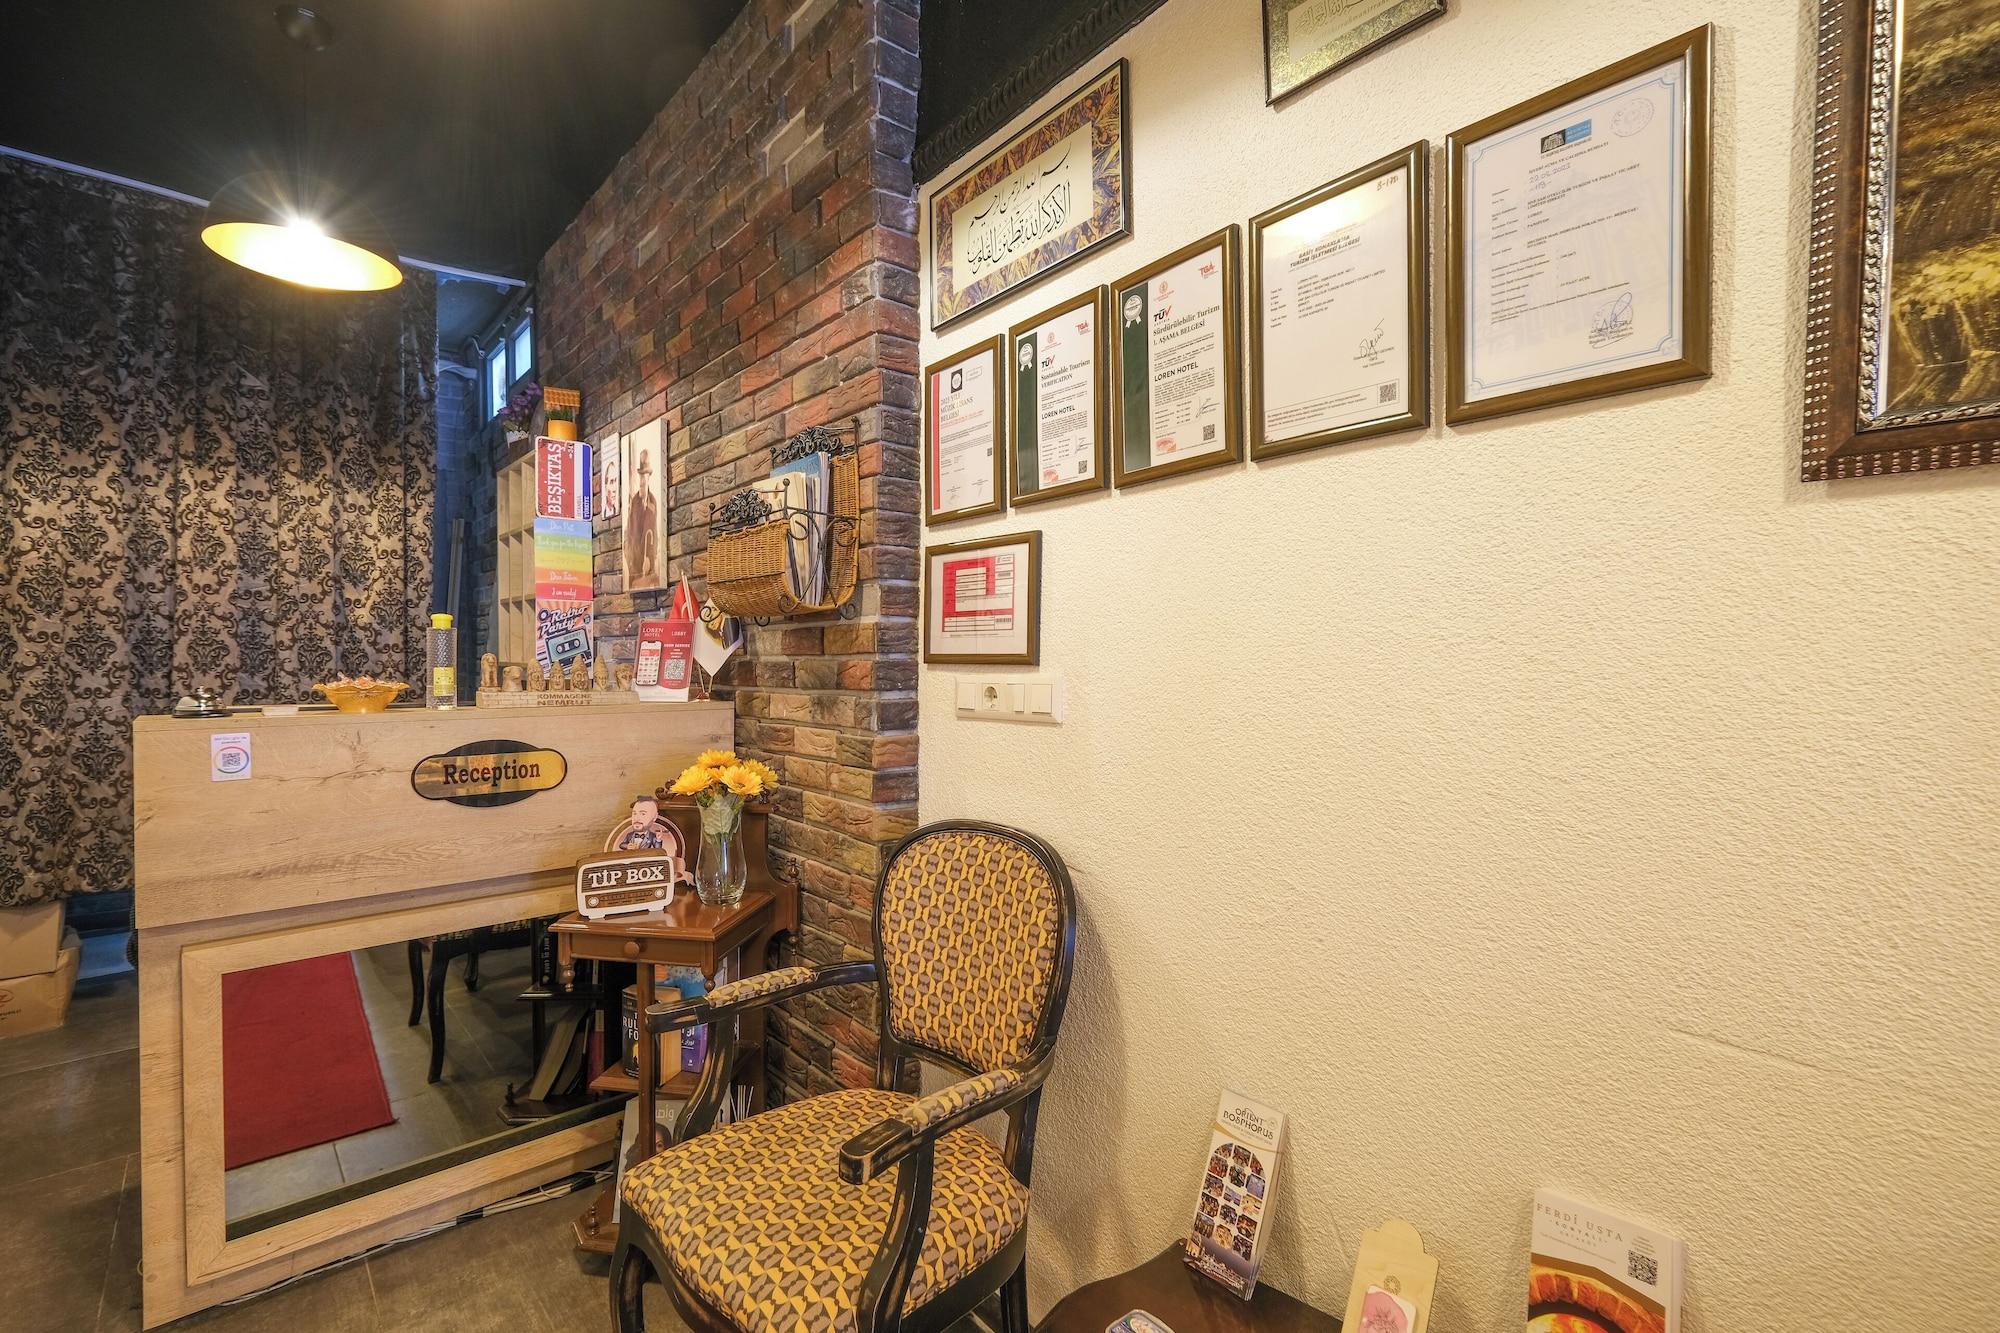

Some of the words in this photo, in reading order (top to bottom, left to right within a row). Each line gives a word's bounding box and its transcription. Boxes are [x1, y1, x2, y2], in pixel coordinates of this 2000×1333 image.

[1197, 305, 1220, 319] Turizm
[1041, 365, 1068, 381] Sustainable
[1069, 359, 1091, 371] Tourism
[1154, 369, 1176, 382] LOREN
[1177, 361, 1199, 374] HOTEL
[1041, 409, 1058, 420] LOREN
[1058, 405, 1076, 415] HOTEL
[544, 443, 566, 514] BEŞİKTAŞ
[551, 605, 590, 624] Retro
[540, 618, 575, 637] Party
[443, 759, 541, 787] Reception
[626, 865, 665, 884] BOX
[622, 1016, 639, 1031] RUL
[628, 1029, 639, 1040] FO
[1223, 1110, 1274, 1140] BOSPHORUS
[1235, 1108, 1264, 1126] ORIENT
[1537, 1203, 1578, 1225] FERDİ
[1586, 1221, 1624, 1242] USTA
